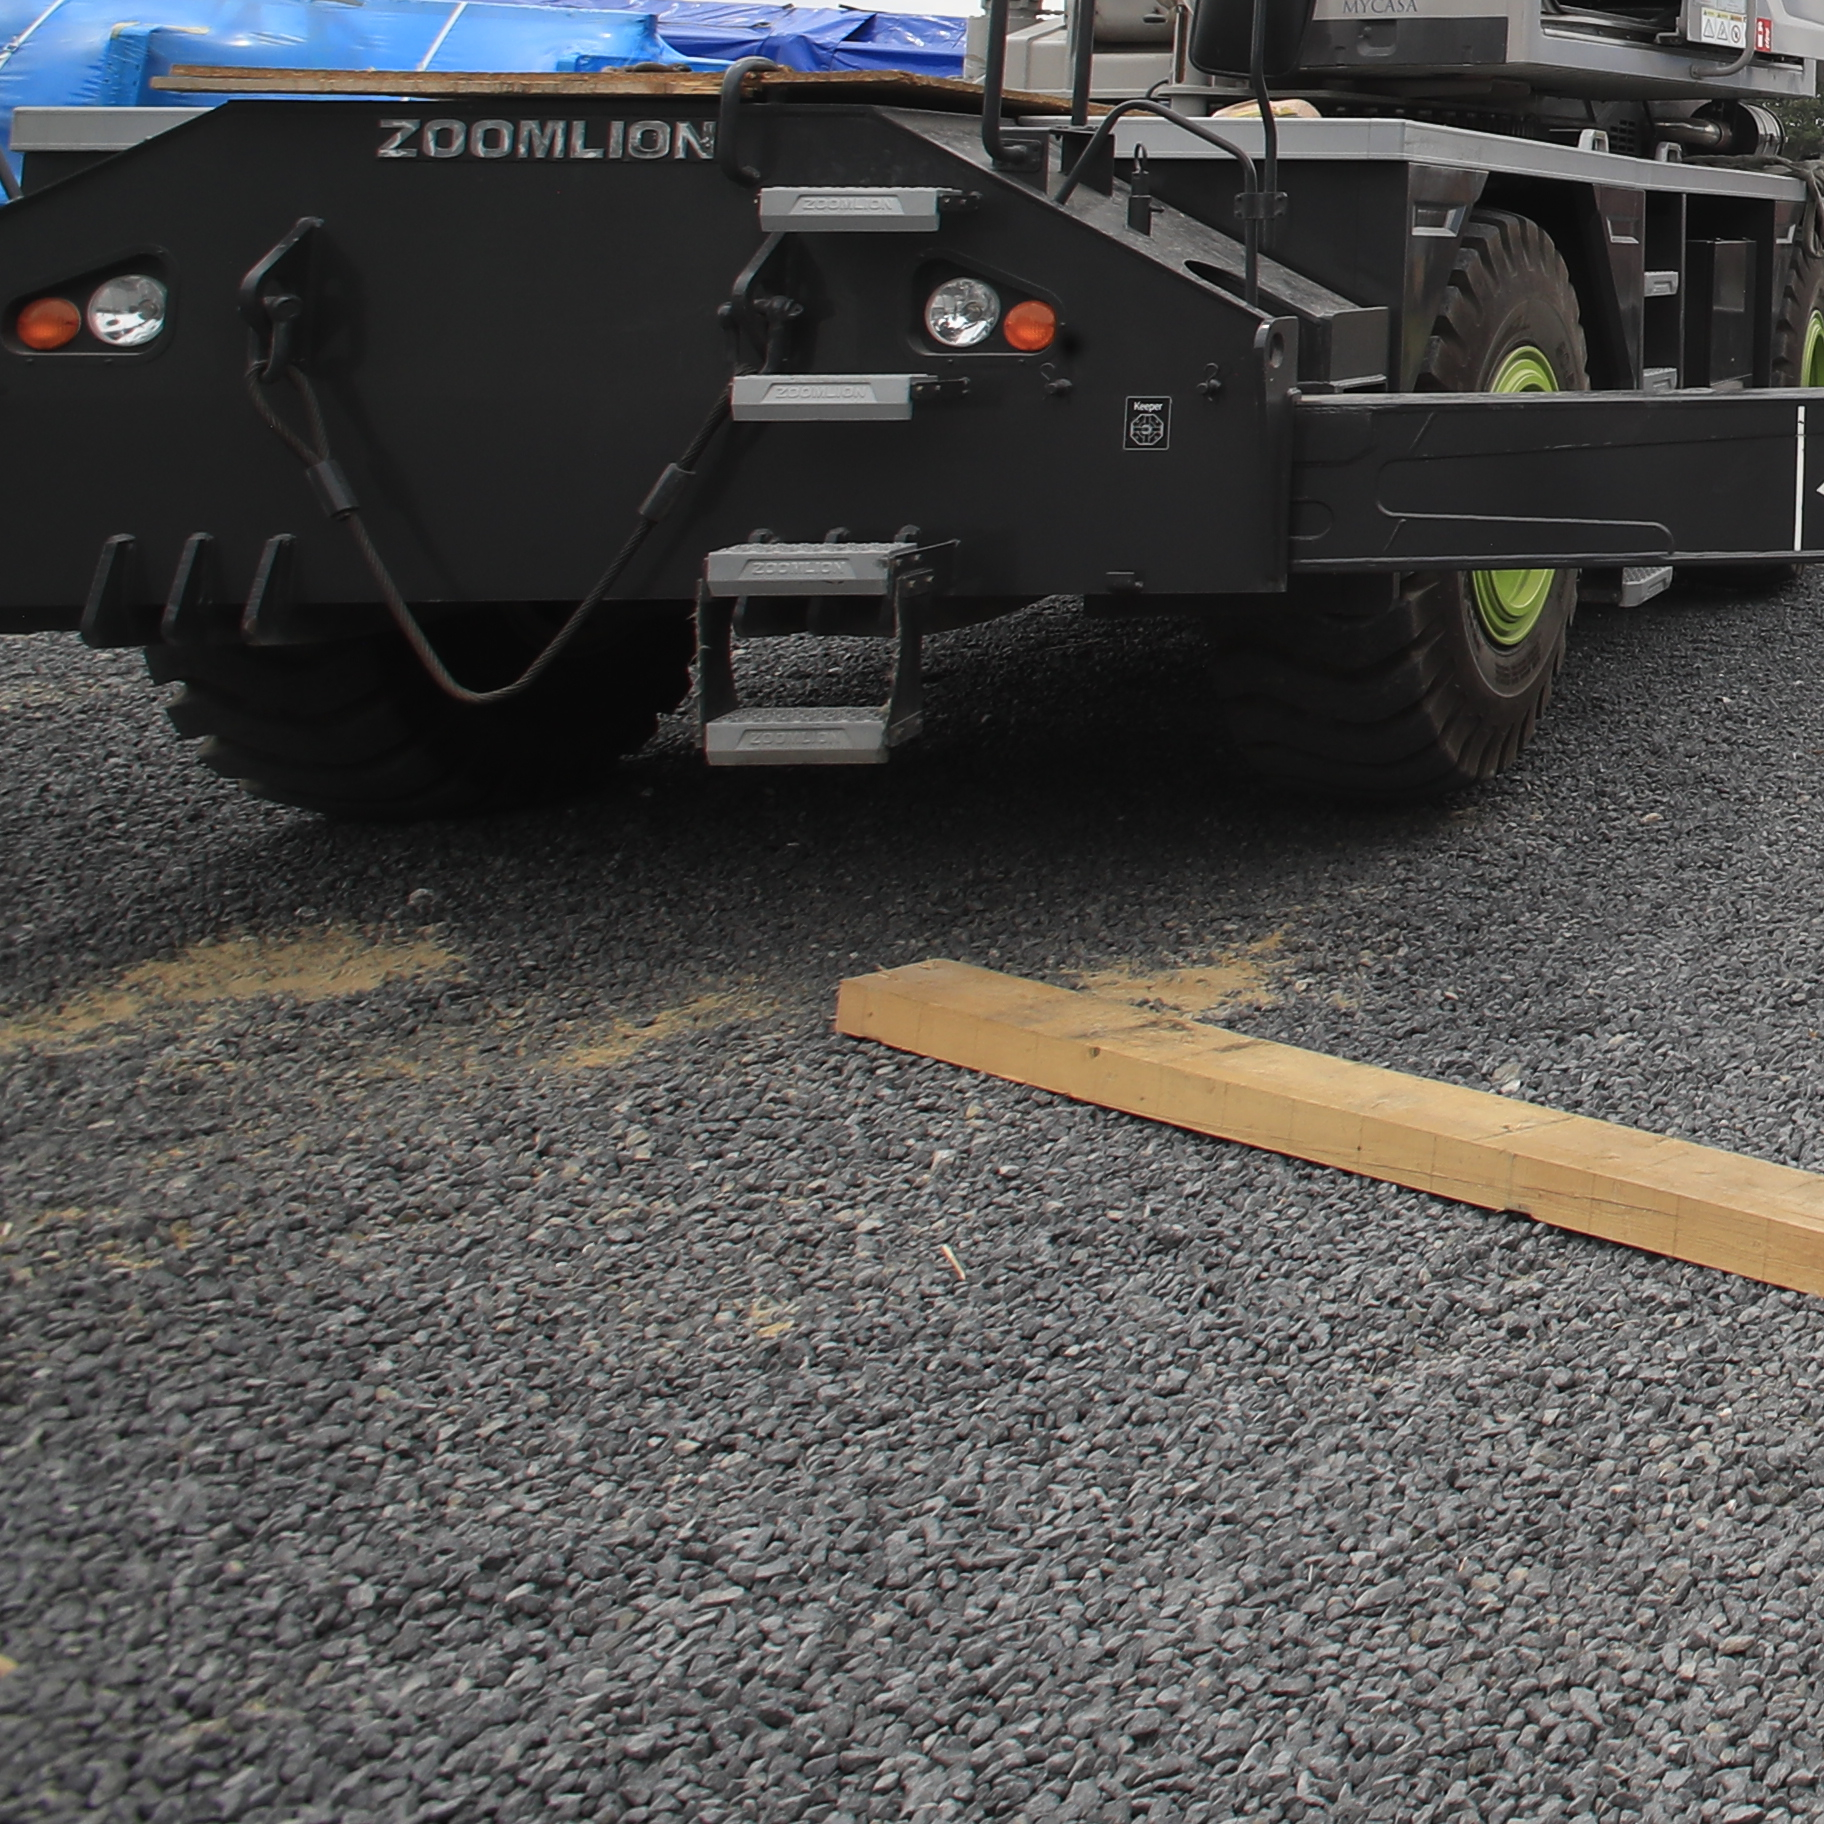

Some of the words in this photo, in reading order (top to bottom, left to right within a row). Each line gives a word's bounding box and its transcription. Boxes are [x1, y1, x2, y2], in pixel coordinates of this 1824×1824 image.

[376, 118, 717, 160] ZOOMLION
[802, 196, 895, 212] ZOOMLION
[775, 383, 867, 400] ZOOMLION
[1133, 401, 1164, 413] Keeper
[751, 560, 847, 576] ZOOMLION
[749, 730, 842, 747] ZOOMLION
